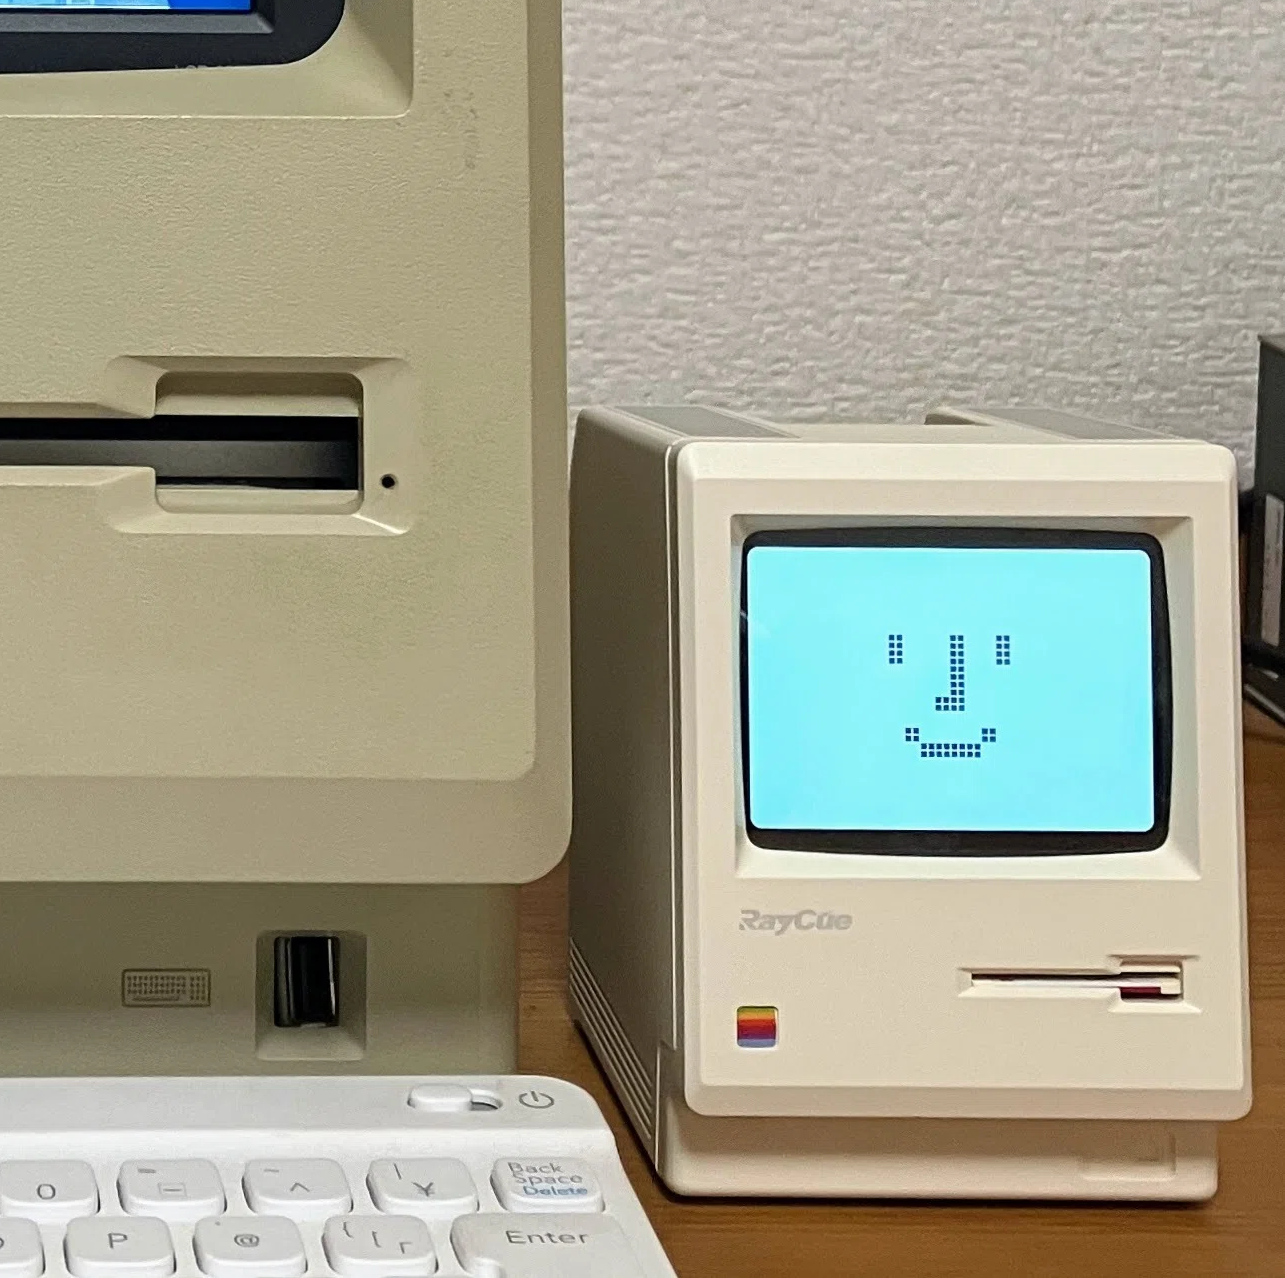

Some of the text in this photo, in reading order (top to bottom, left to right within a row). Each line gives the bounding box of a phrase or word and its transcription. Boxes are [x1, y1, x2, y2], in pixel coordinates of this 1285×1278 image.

[739, 909, 853, 936] RayCue
[508, 1162, 563, 1174] Back
[513, 1173, 582, 1186] Space
[37, 1183, 55, 1199] 0
[413, 1182, 435, 1197] ¥
[523, 1186, 588, 1195] Delete
[107, 1233, 127, 1248] P
[234, 1234, 259, 1247] @
[506, 1230, 590, 1244] Enter
